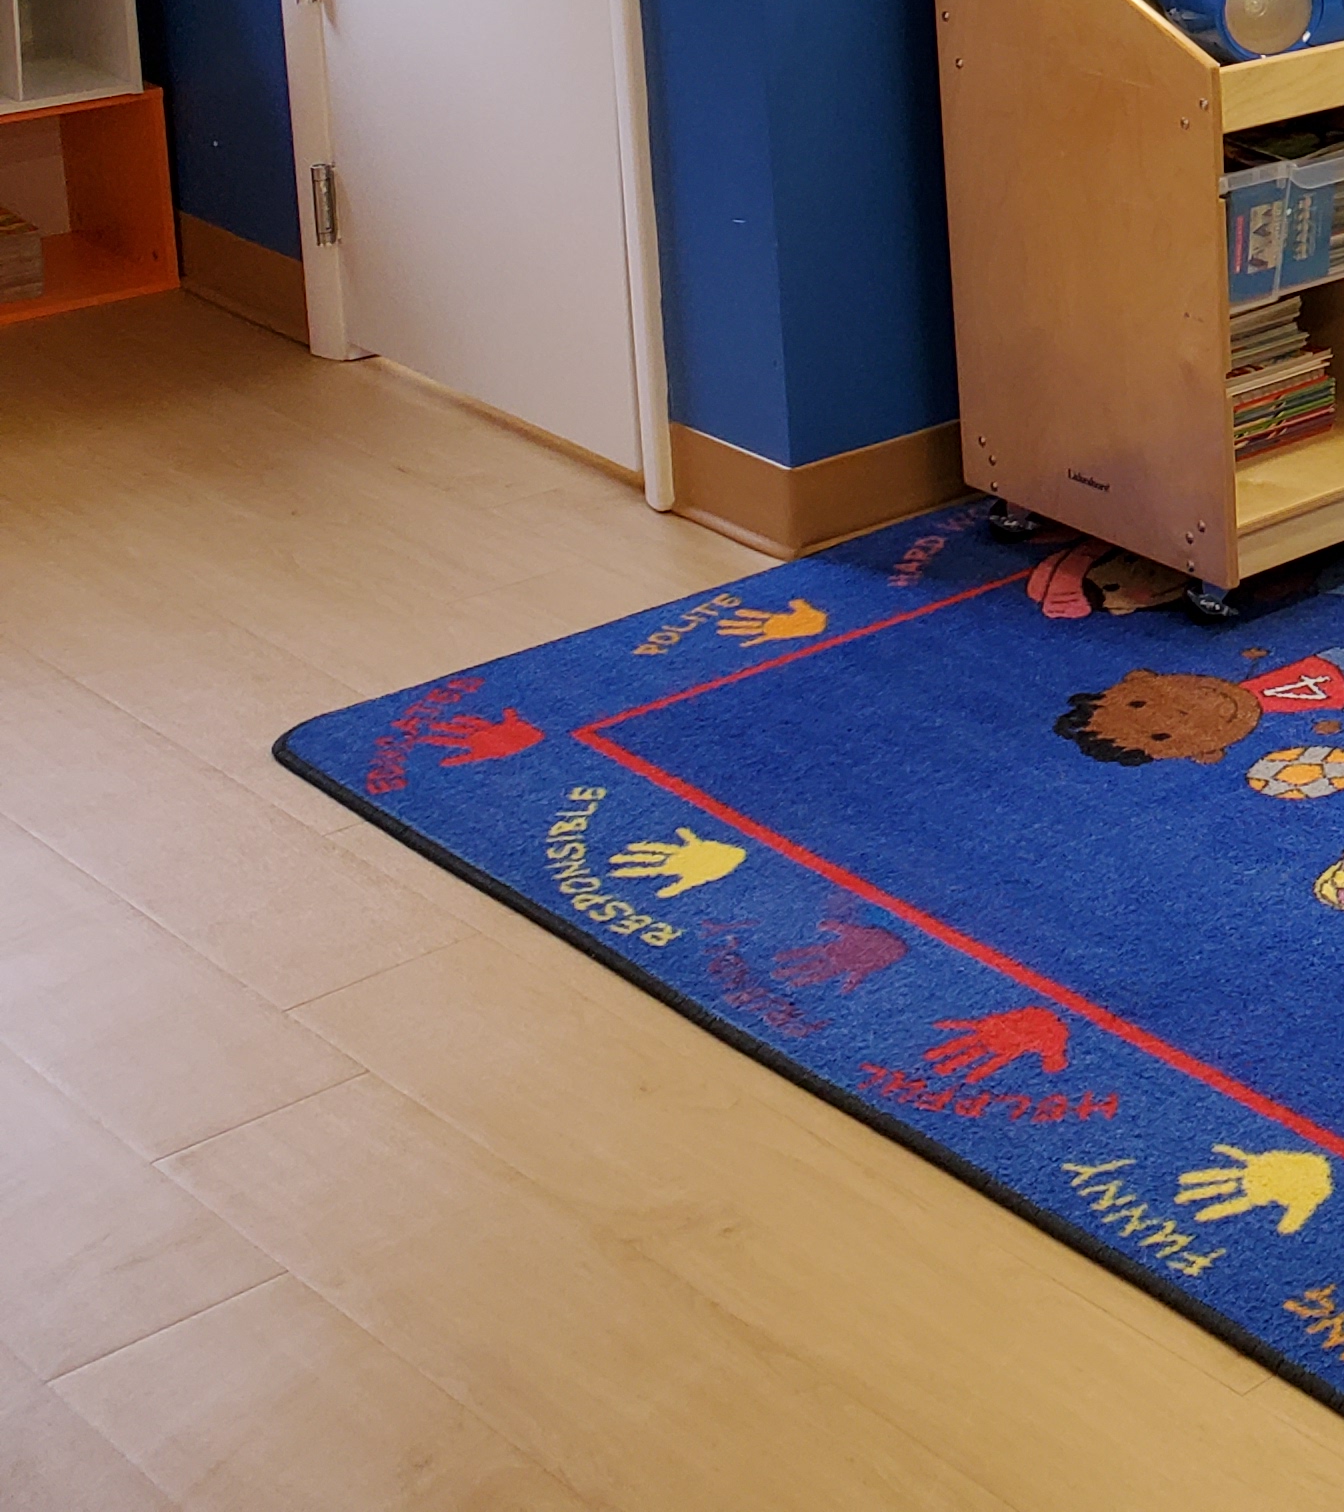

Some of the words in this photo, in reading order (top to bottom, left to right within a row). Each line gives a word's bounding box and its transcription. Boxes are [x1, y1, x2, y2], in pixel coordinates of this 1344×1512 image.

[887, 535, 946, 587] HARD
[634, 593, 743, 657] POLITE
[545, 785, 686, 948] RESPONSIBLE
[1061, 1156, 1229, 1279] FUNNY
